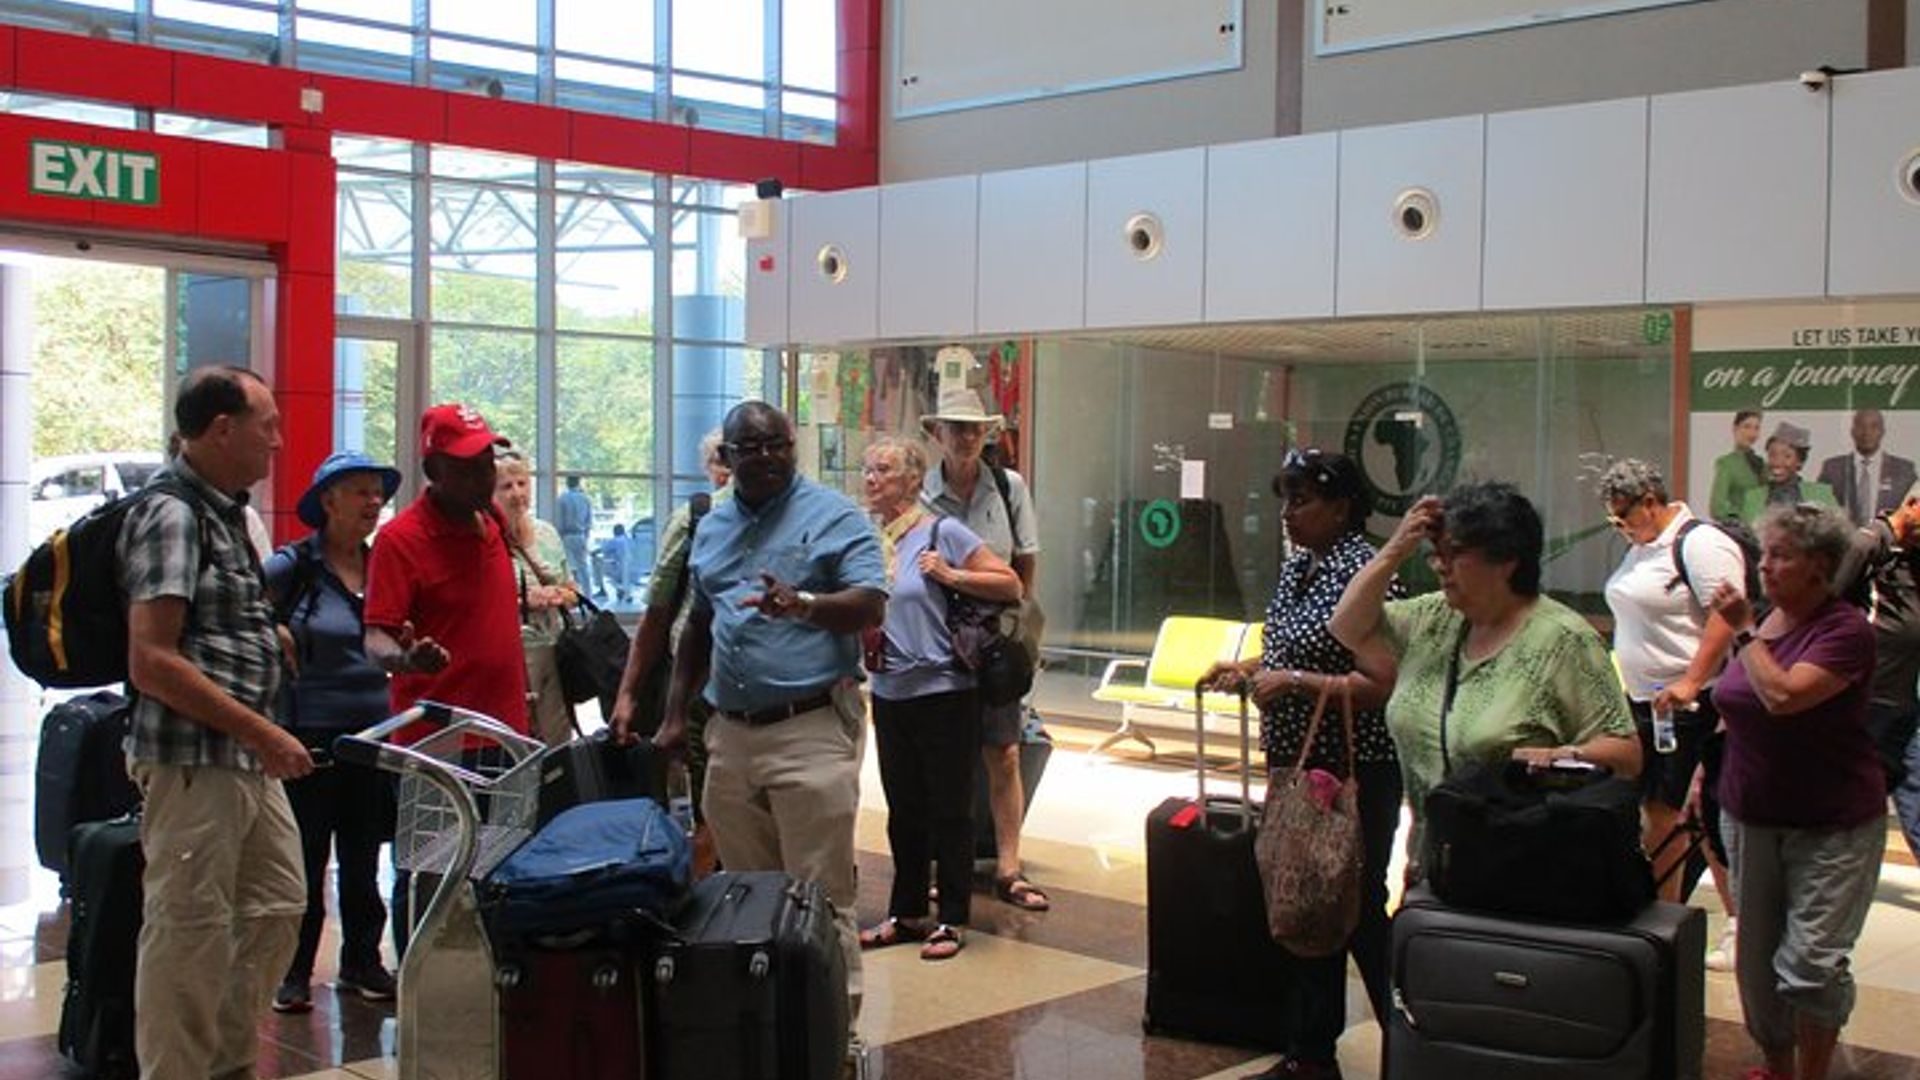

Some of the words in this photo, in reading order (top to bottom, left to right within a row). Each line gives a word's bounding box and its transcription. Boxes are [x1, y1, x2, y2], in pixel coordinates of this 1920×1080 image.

[32, 142, 156, 201] EXIT
[1793, 329, 1822, 346] LET
[1828, 328, 1851, 345] US
[1857, 326, 1900, 344] TAKE
[1904, 326, 1920, 343] Y
[1703, 367, 1745, 389] on
[1750, 366, 1775, 387] a
[1762, 359, 1919, 407] journey
